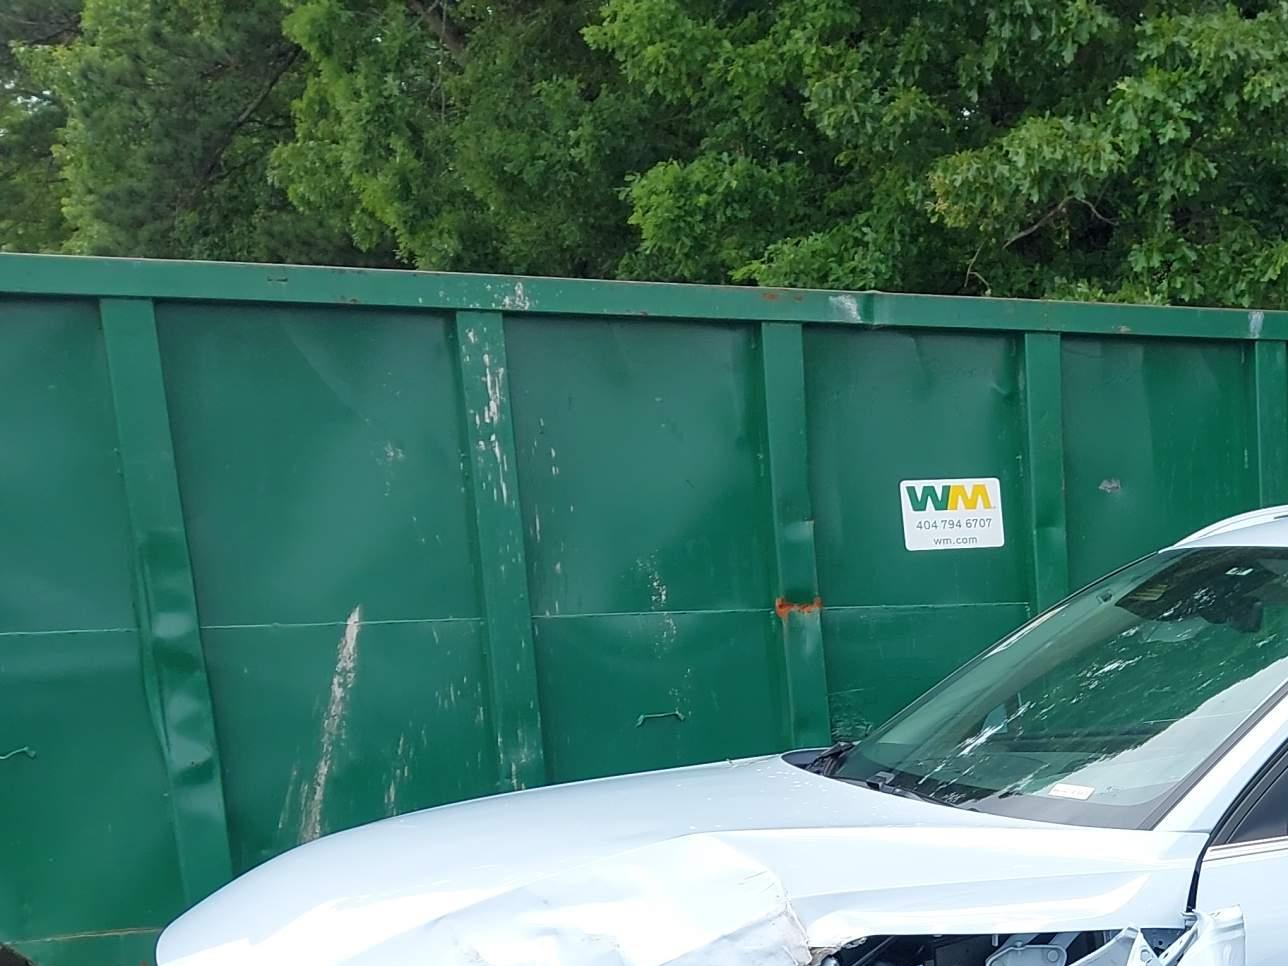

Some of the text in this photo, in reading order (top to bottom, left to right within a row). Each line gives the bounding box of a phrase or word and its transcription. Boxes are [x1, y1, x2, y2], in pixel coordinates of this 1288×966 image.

[905, 484, 992, 511] WM
[916, 518, 992, 530] 404 794 6707
[933, 536, 978, 545] wm.com
